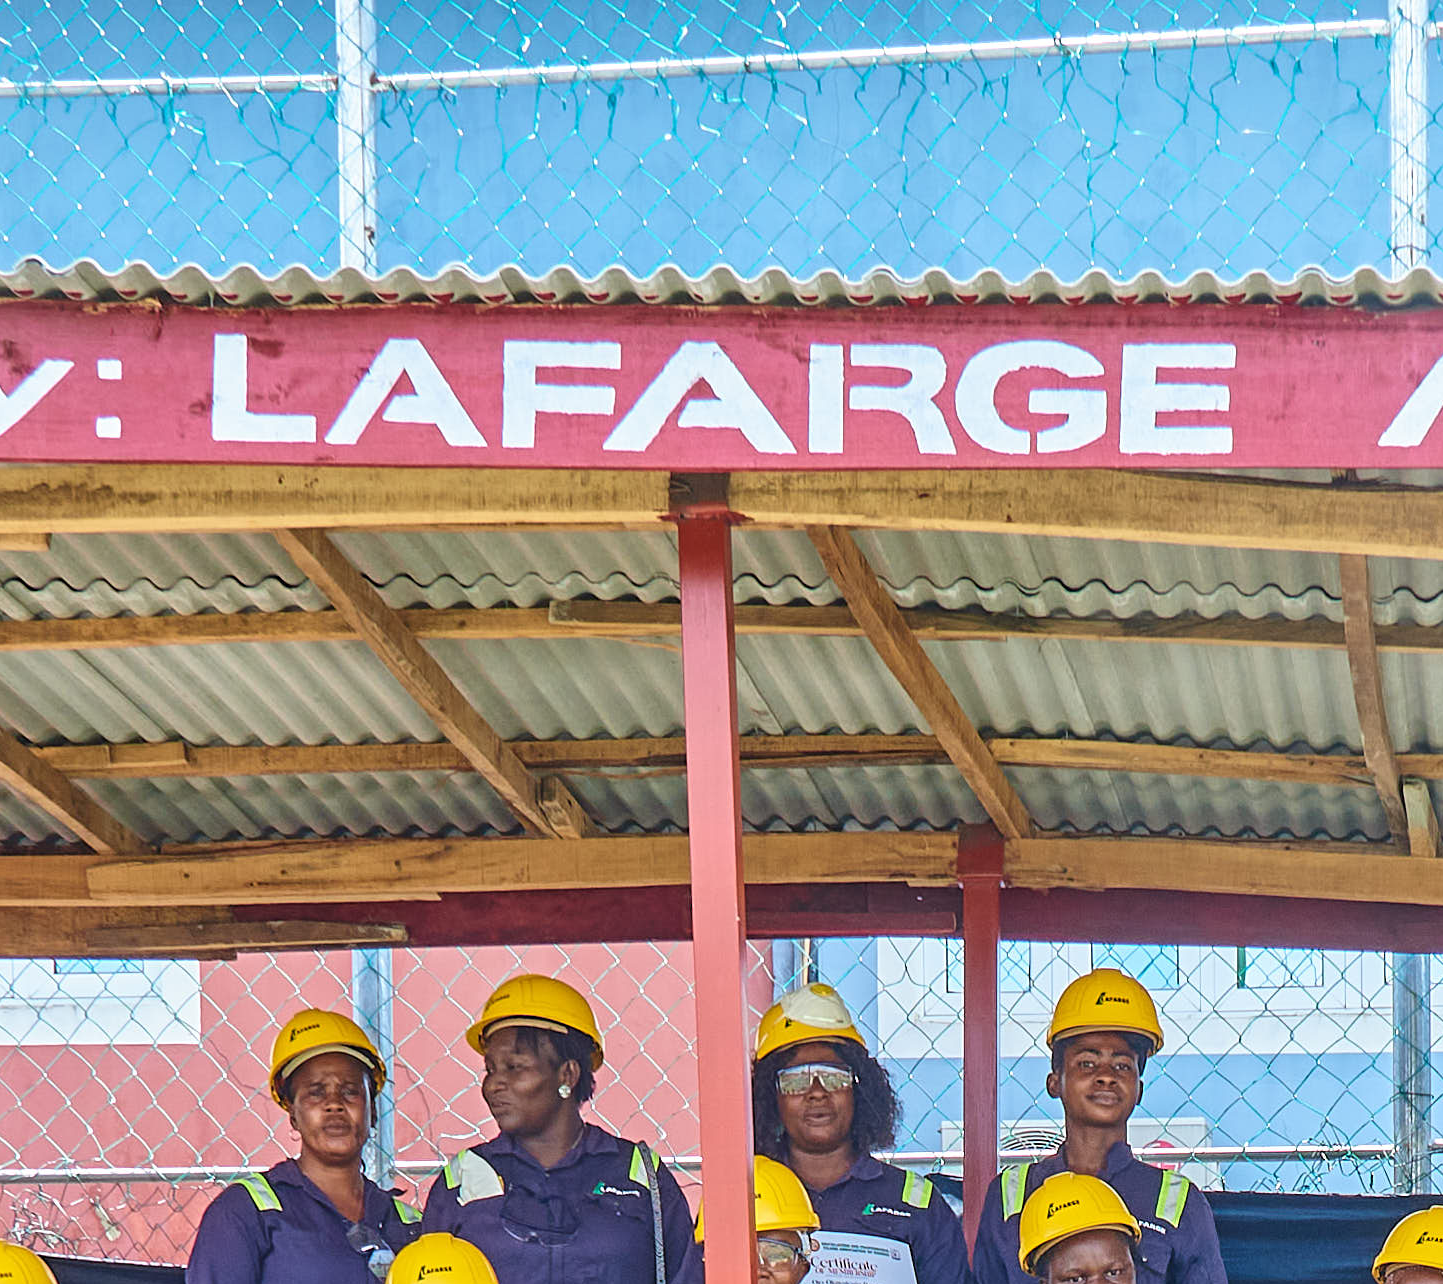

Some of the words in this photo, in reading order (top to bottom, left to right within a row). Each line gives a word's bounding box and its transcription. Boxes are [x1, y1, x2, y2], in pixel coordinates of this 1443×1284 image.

[211, 333, 1237, 456] LAFARGE
[1095, 991, 1130, 1006] LAFARGE
[1046, 1199, 1080, 1220] LAFARGE
[1137, 1219, 1166, 1235] FARGE
[810, 1254, 878, 1272] Certificate
[417, 1265, 453, 1282] LAFARGE
[827, 1266, 876, 1278] MEMBERSHIP
